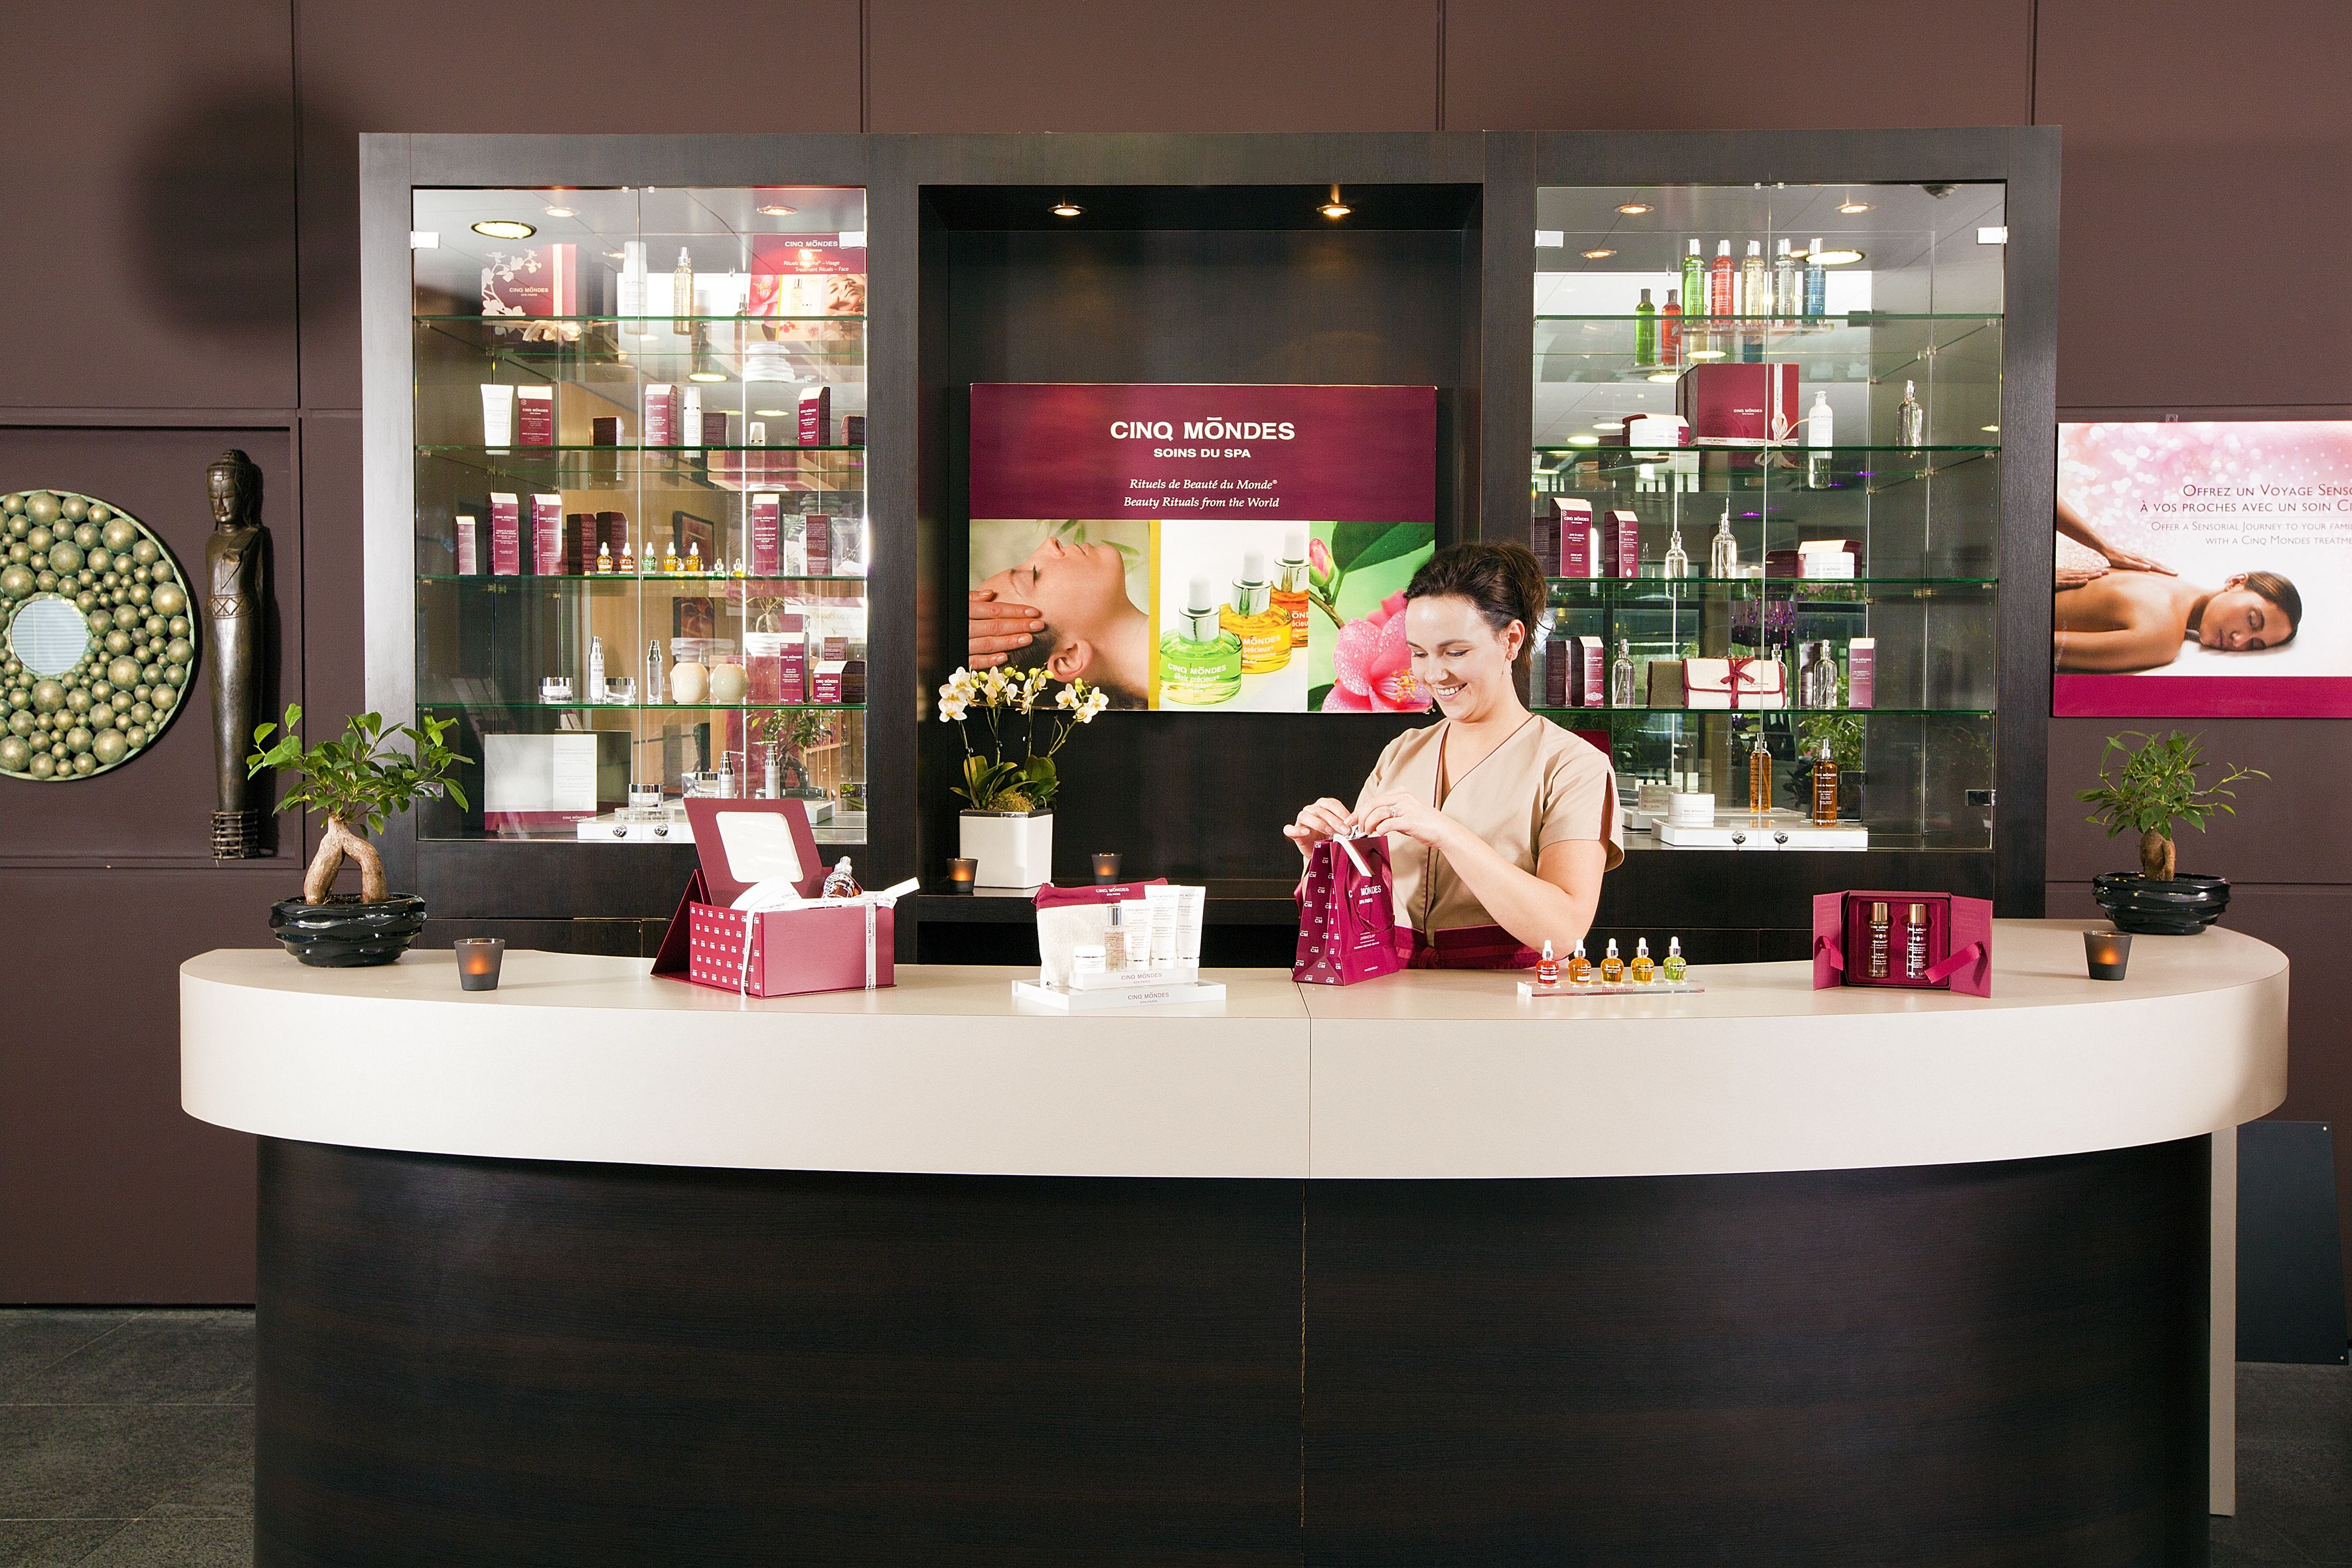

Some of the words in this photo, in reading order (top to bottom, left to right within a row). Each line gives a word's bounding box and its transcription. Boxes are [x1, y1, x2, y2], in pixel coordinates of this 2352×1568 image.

[1110, 422, 1174, 441] CINQ
[1154, 449, 1196, 457] SOINS
[1201, 449, 1219, 457] DU
[1224, 449, 1251, 457] SPA
[1130, 479, 1166, 489] Rituels
[1169, 479, 1180, 489] de
[1184, 479, 1218, 489] Beauté
[1220, 479, 1234, 489] du
[1124, 497, 1159, 509] Beauty
[1162, 497, 1200, 507] Rituals
[1200, 497, 1227, 509] from
[1229, 498, 1244, 507] the
[1247, 498, 1279, 507] World
[1168, 663, 1187, 674] CINQ
